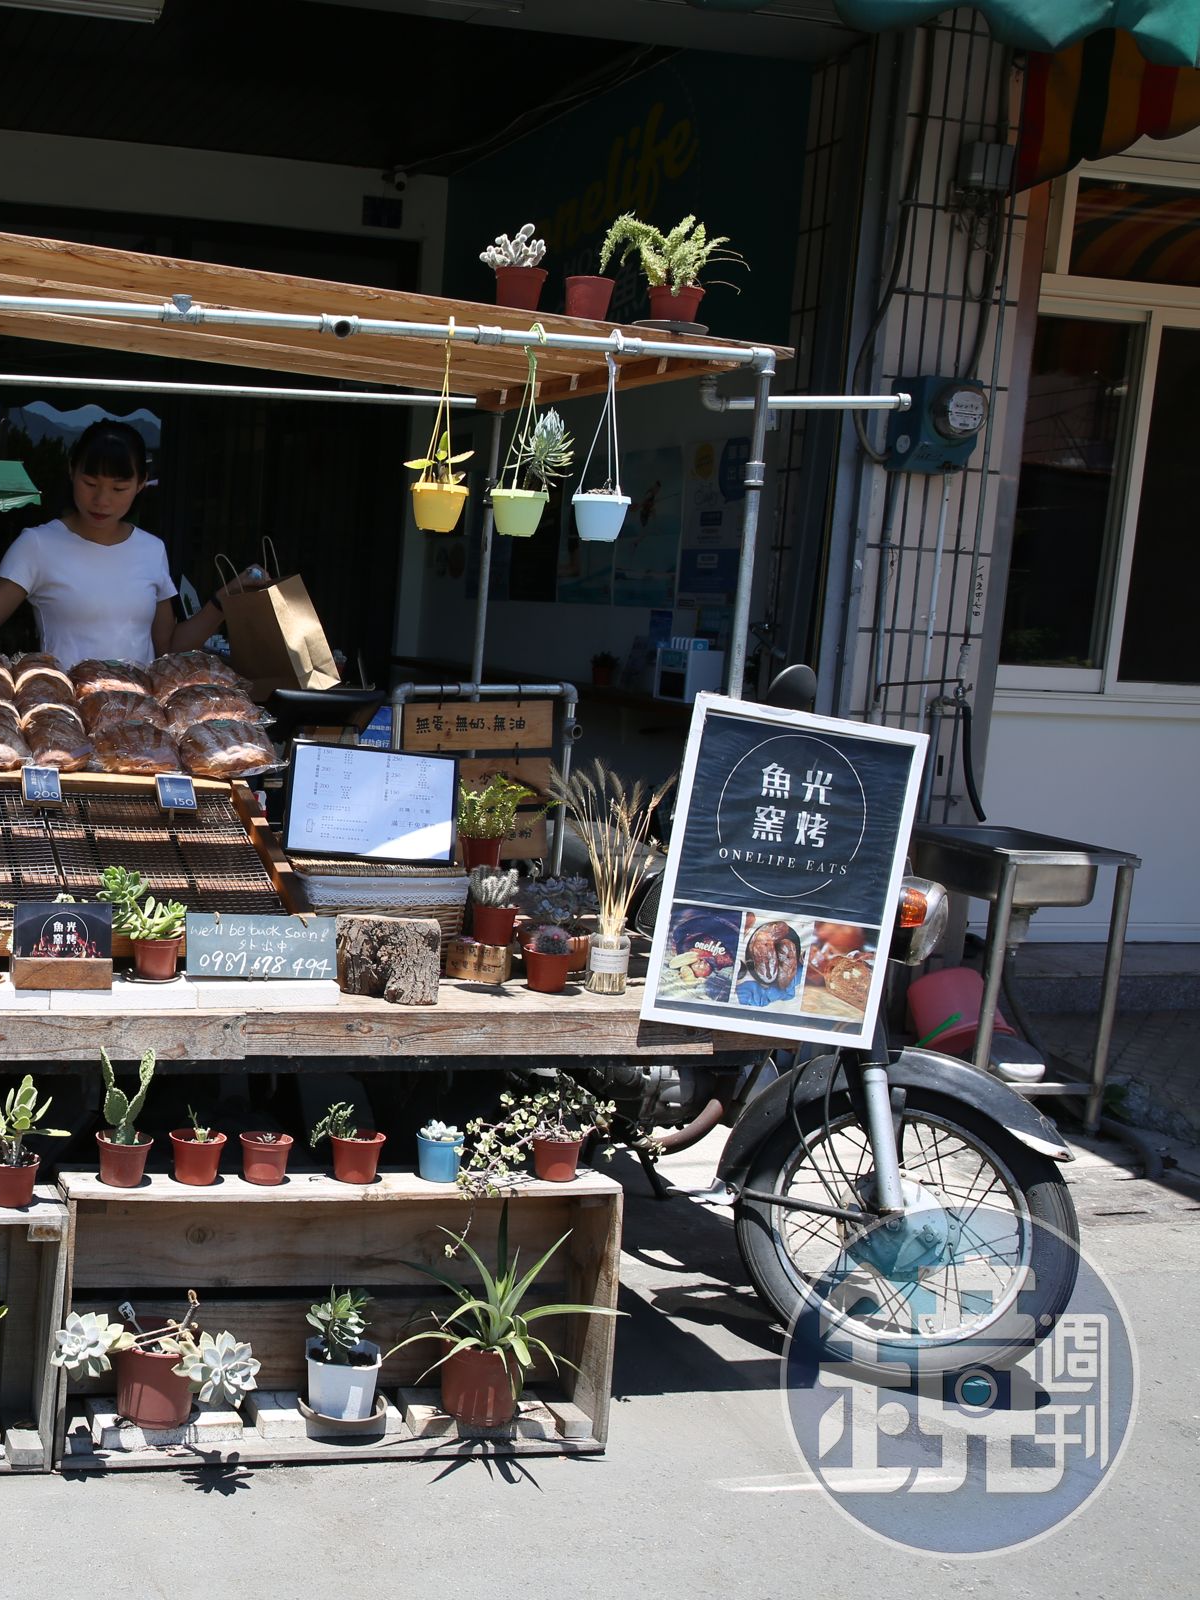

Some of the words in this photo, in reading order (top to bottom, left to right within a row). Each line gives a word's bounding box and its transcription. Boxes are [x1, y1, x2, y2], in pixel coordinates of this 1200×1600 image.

[761, 762, 833, 806] 魚光
[33, 790, 59, 799] 200
[173, 797, 194, 807] 150
[752, 805, 829, 848] 窯烤
[719, 847, 796, 869] ONELIFE
[805, 859, 848, 875] EATS
[53, 921, 77, 933] 魚光
[229, 923, 246, 936] be
[694, 940, 727, 956] onelife
